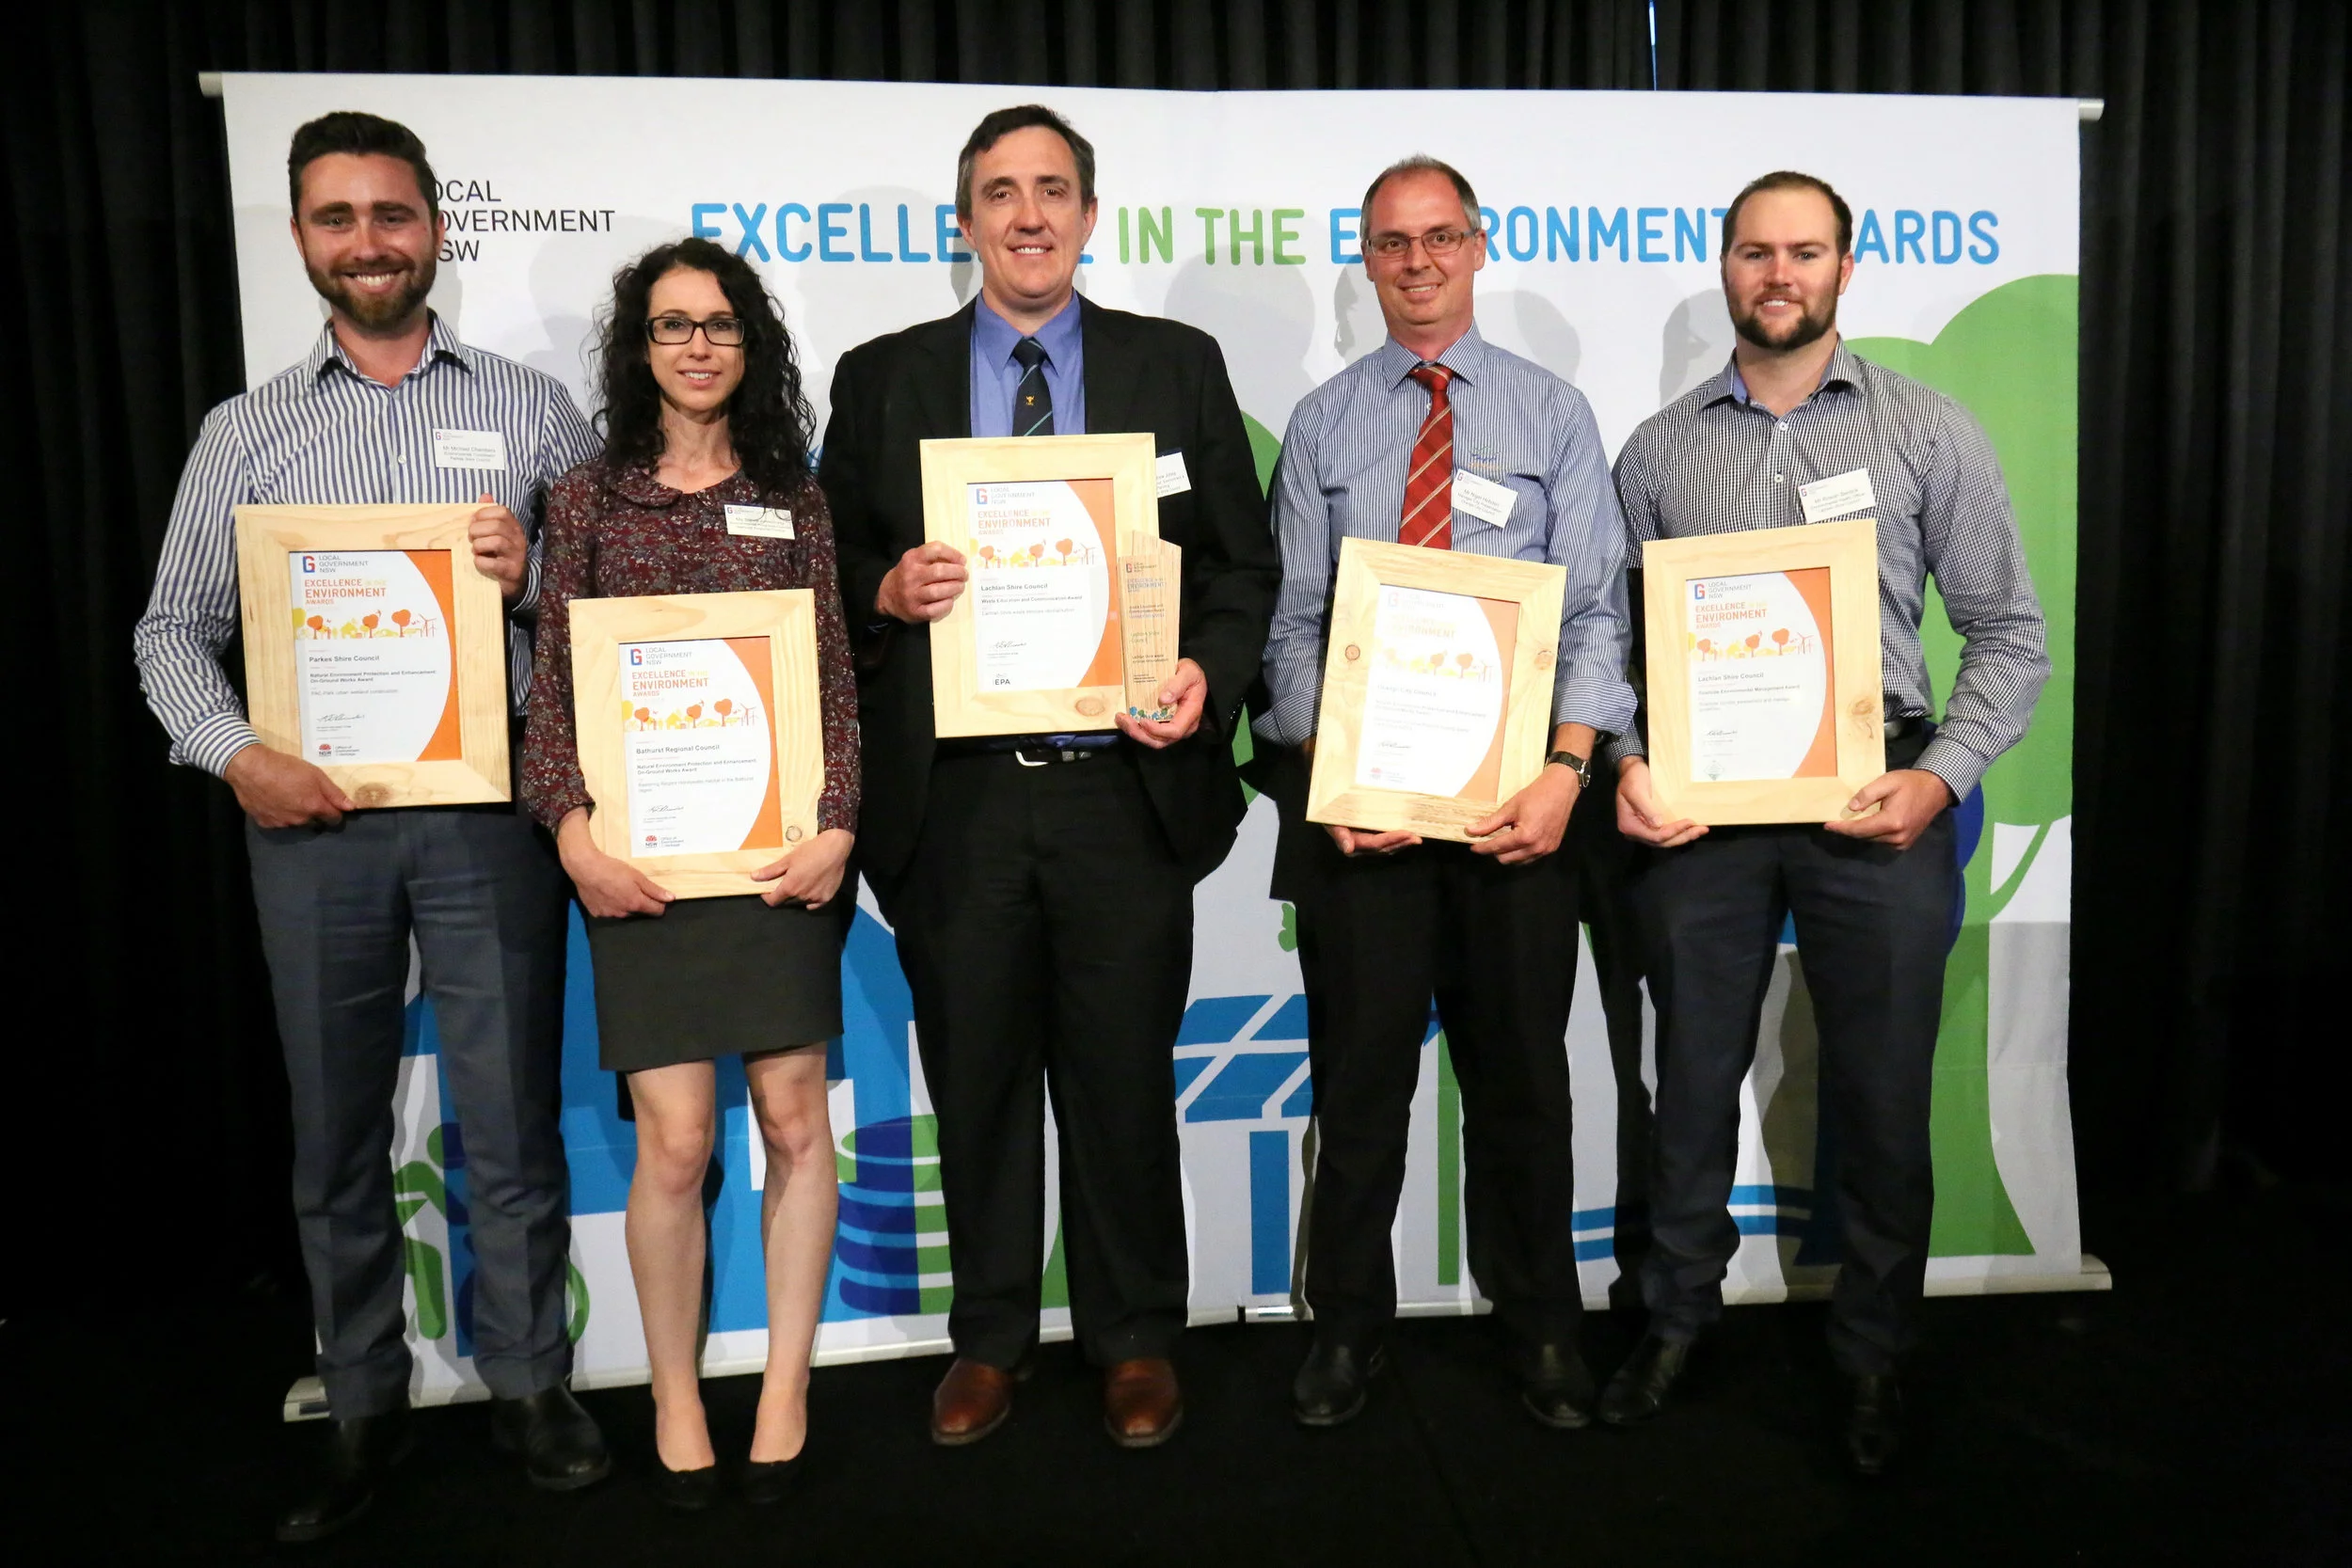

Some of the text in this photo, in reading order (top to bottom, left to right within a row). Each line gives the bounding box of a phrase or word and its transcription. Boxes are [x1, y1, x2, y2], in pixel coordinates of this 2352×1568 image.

[436, 180, 501, 202] CAL
[442, 210, 614, 232] VERNMENT
[691, 202, 1093, 263] EXCELLE
[1118, 206, 1173, 264] IN
[1196, 207, 1306, 265] THE
[1854, 209, 1999, 265] ARDS
[438, 239, 479, 261] SW
[977, 509, 1030, 518] EXCELLENCE
[977, 517, 1051, 529] ENVIRONMENT
[304, 578, 362, 587] EXCELLENCE
[305, 587, 387, 598] ENVIRONMENT
[1708, 584, 1752, 593] GOVERNMENT
[1695, 602, 1745, 613] EXCELLENCE
[1696, 609, 1767, 623] ENVIRONMENT
[632, 670, 686, 679] EXCELLENCE
[632, 677, 708, 690] ENVIRONMENT
[665, 746, 693, 754] Regional
